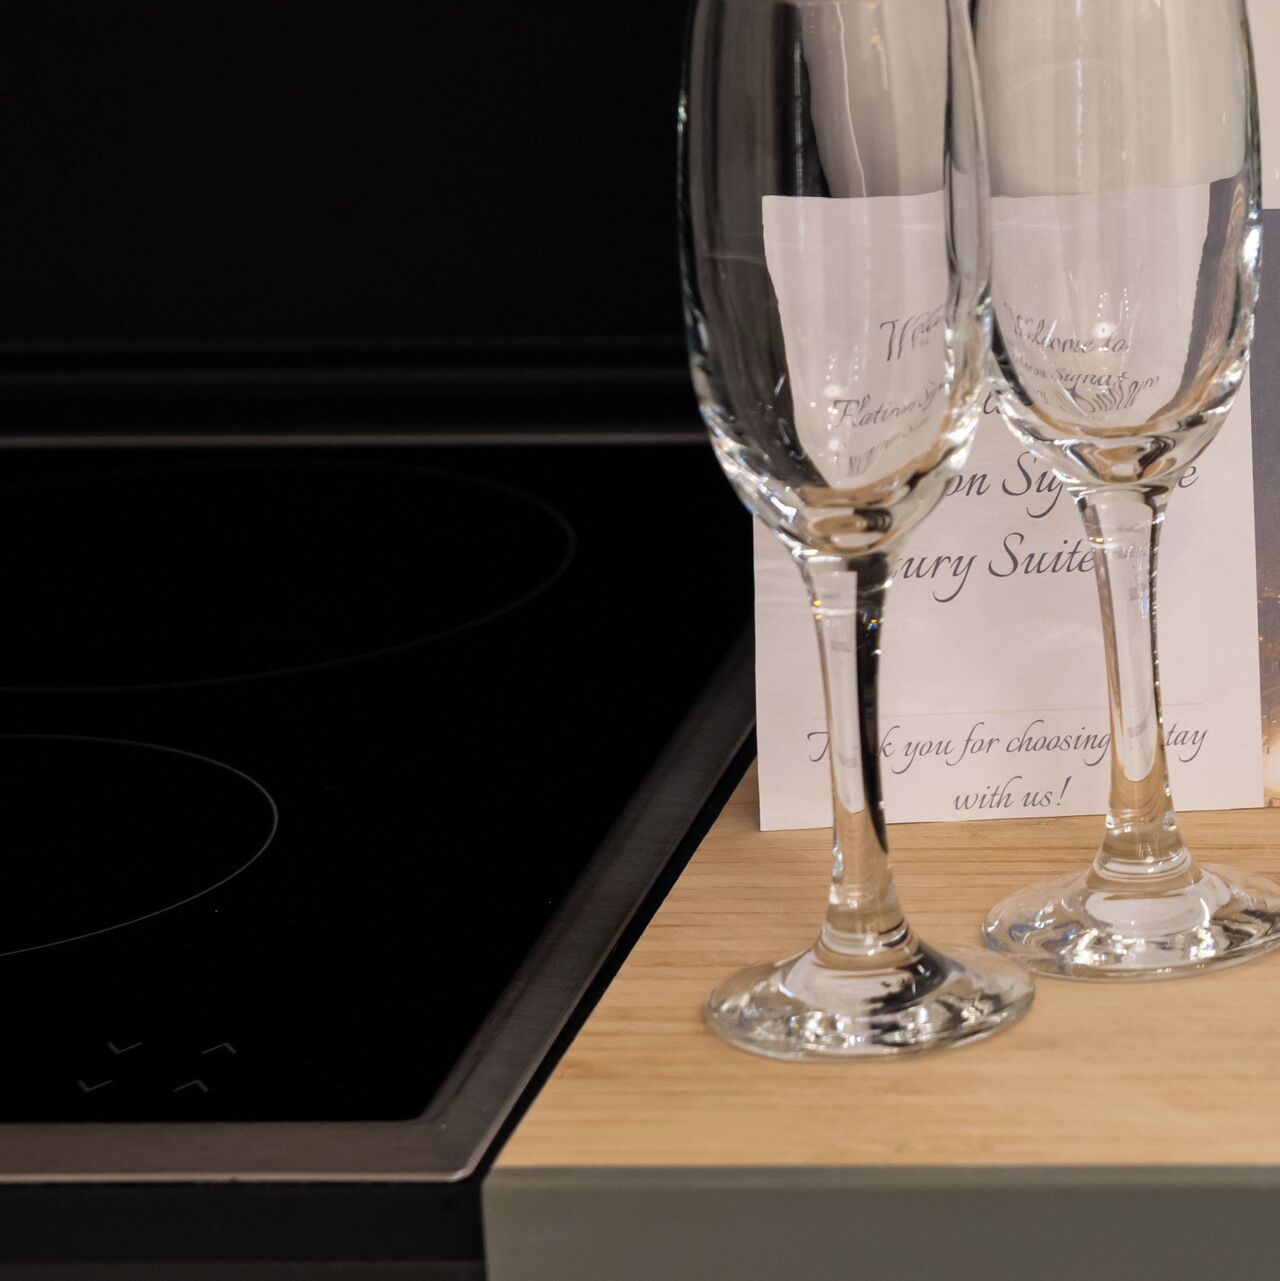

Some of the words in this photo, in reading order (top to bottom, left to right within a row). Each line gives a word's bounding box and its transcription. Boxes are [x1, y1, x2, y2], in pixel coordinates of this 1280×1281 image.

[988, 532, 1096, 578] Suite
[891, 738, 955, 774] you
[945, 721, 1000, 766] for
[1006, 720, 1111, 767] choosing
[1165, 721, 1209, 765] tay
[953, 775, 1016, 811] with
[1021, 775, 1071, 808] us!
